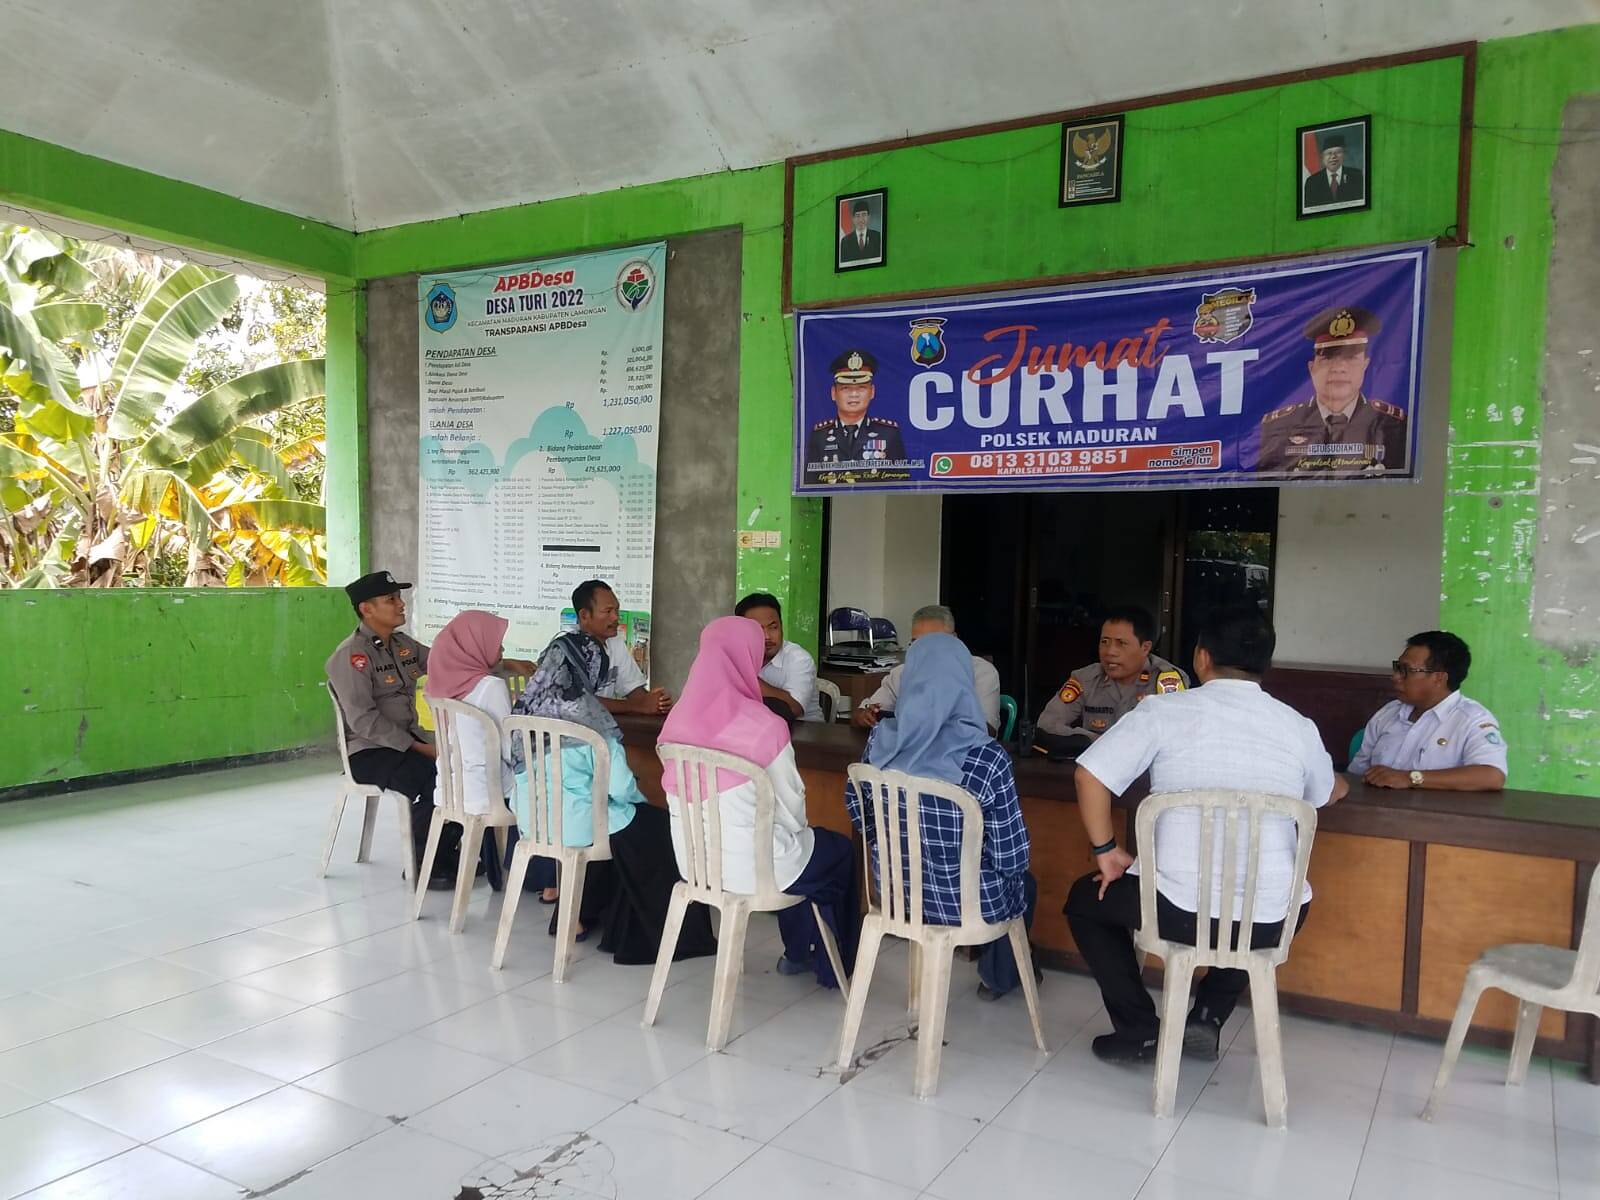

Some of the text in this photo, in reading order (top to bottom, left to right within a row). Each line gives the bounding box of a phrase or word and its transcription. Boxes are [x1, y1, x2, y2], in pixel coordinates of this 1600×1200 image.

[493, 270, 575, 293] APBDesa
[486, 289, 584, 315] DESA TURI 2022
[467, 307, 607, 327] KECAMATAN MADURAN KABUPATEN LAMONGAN
[485, 320, 587, 337] TRANSPARANSI APBDesa
[425, 346, 497, 358] PENDAPATAN DESA
[967, 318, 1173, 385] Jumat
[908, 349, 1260, 430] CURHAT
[565, 401, 575, 411] Rp
[456, 420, 474, 429] DESA
[564, 429, 574, 439] Rp
[980, 427, 1157, 448] POLSEK MADURAN
[547, 445, 566, 453] Bidang
[567, 443, 603, 451] Pelaksanaan
[1172, 446, 1212, 458] simpen
[546, 456, 586, 464] Pembangunan
[970, 449, 1128, 468] 0813 3103 9851
[1195, 455, 1212, 465] lur
[997, 465, 1092, 475] KAPOLSEK MADURAN
